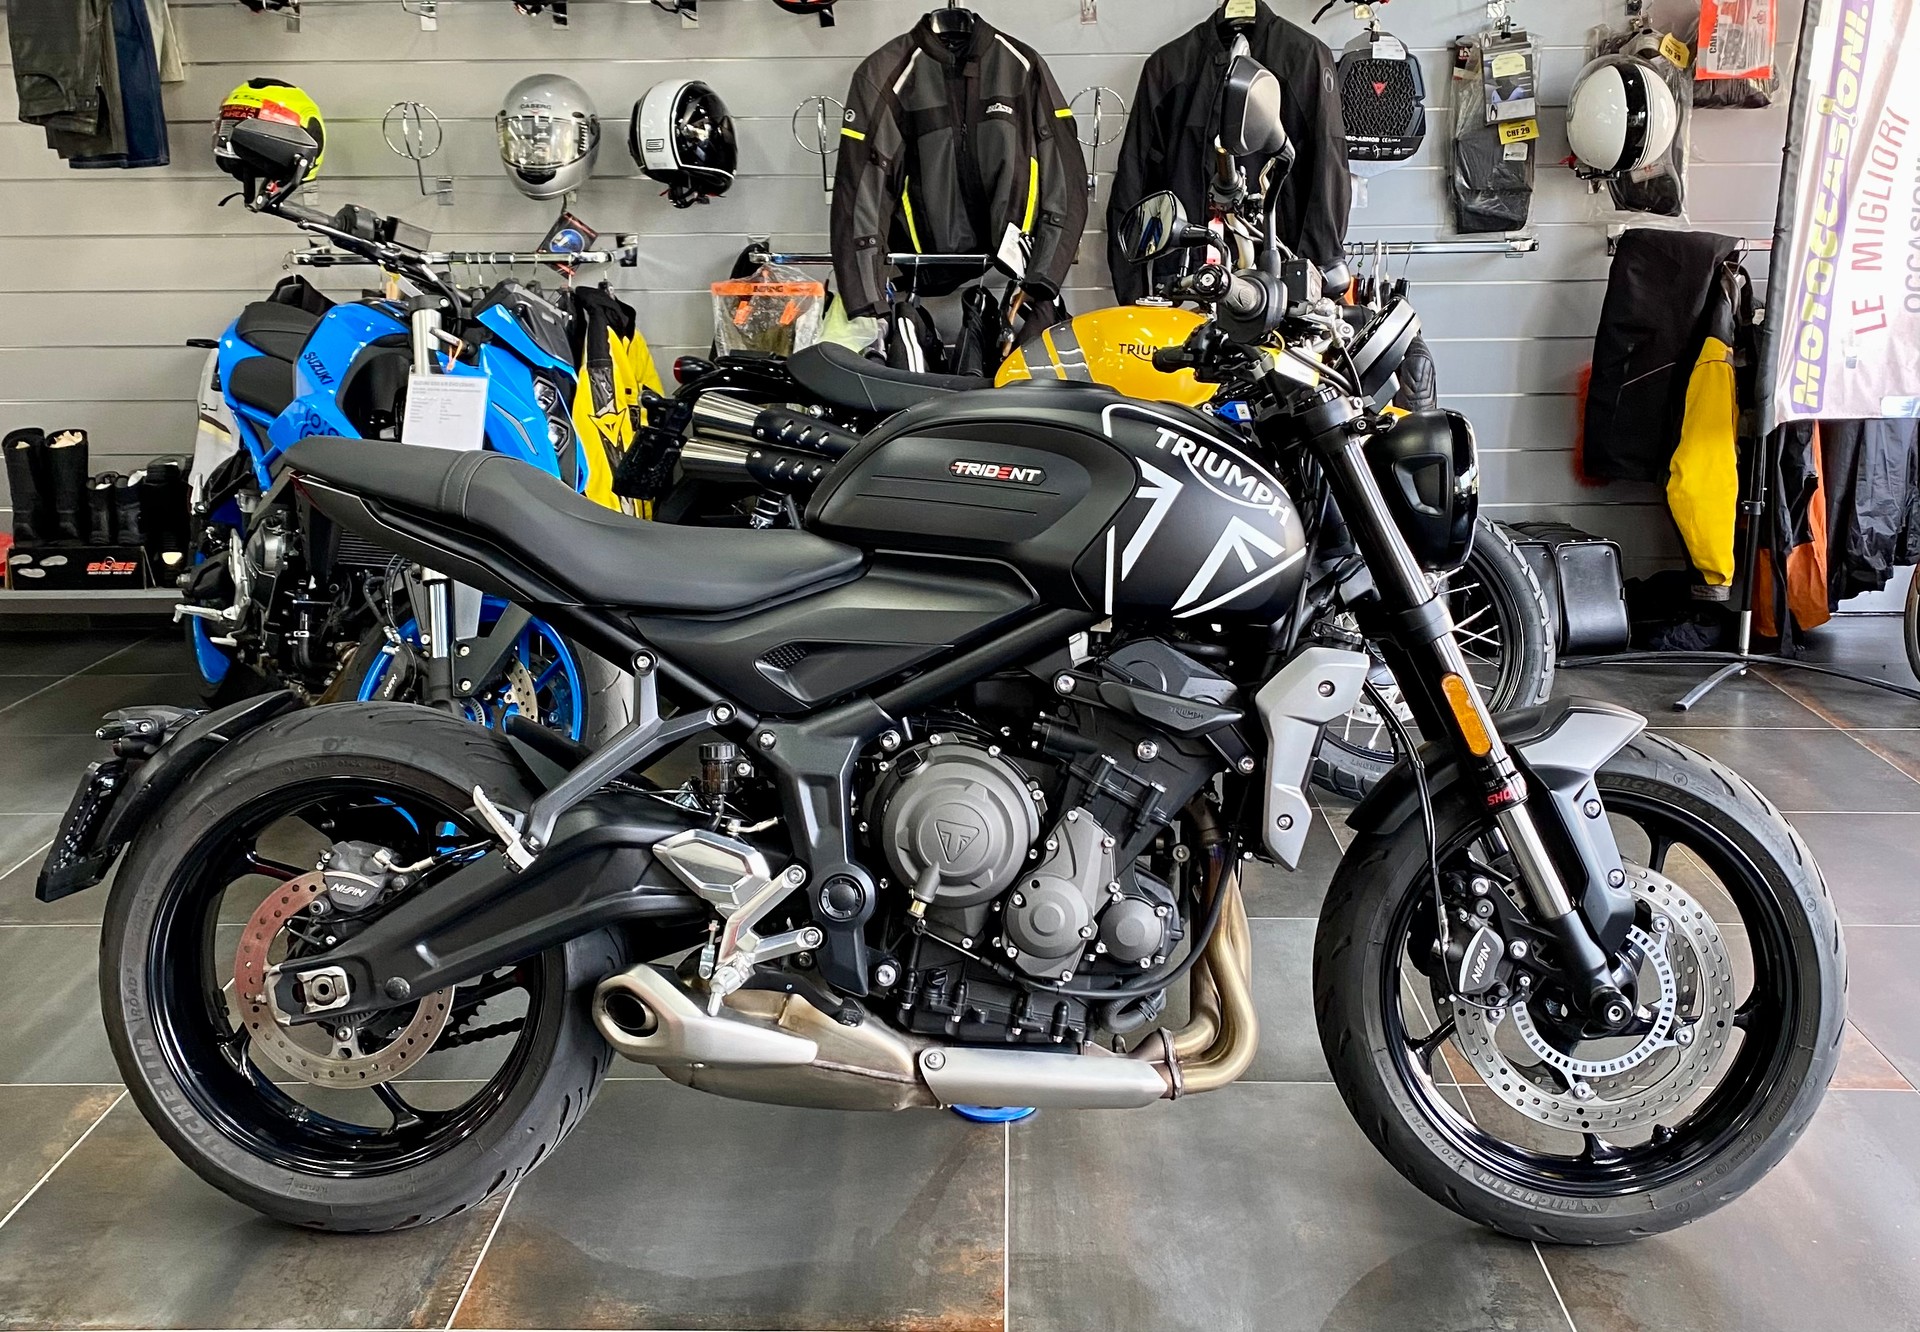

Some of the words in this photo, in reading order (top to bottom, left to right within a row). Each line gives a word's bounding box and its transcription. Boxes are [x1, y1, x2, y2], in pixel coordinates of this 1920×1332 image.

[1506, 129, 1520, 138] CHF
[1520, 126, 1531, 135] 29
[1793, 0, 1868, 408] MOTOCCASIONI.
[1851, 106, 1910, 271] MIGLIORI
[1903, 156, 1920, 314] OCCAS
[1852, 295, 1887, 335] LE
[304, 351, 334, 385] SUZUKI
[951, 461, 1042, 482] TRIDENT
[1155, 426, 1290, 527] TRIUMPH
[1487, 788, 1512, 806] SHO
[1401, 1101, 1413, 1113] 17
[1411, 1115, 1427, 1129] ZR
[1425, 1131, 1461, 1165] 120/70
[1478, 1172, 1578, 1211] MICHELIN
